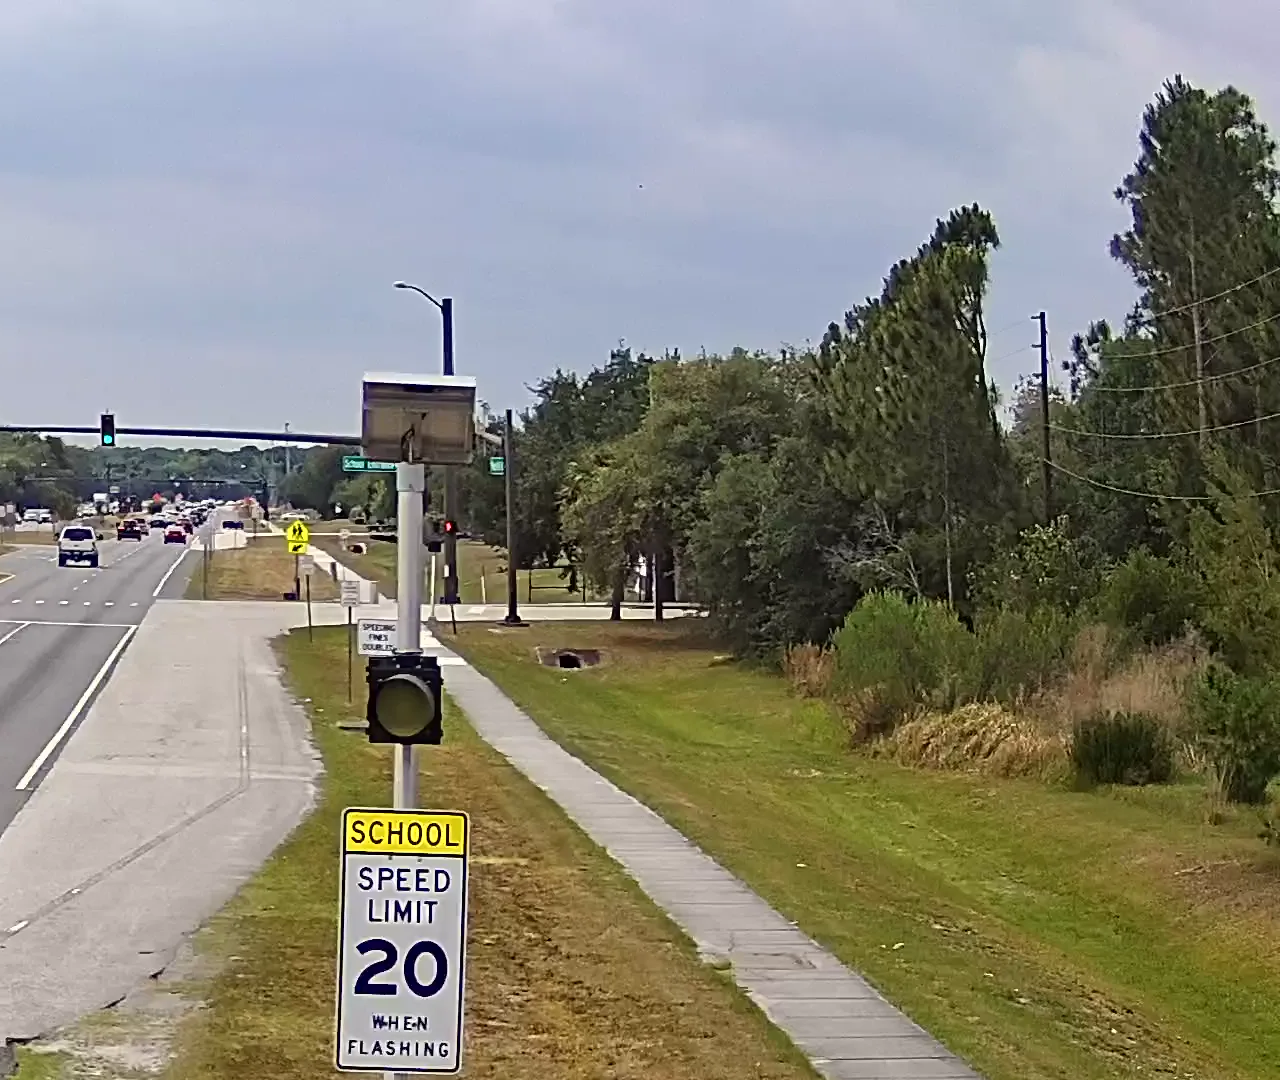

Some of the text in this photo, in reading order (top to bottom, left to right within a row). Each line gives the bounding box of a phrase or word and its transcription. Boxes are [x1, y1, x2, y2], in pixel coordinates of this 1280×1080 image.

[368, 633, 389, 642] FINES
[351, 820, 460, 847] SCHOOL
[357, 866, 451, 893] SPEED
[368, 899, 439, 924] LIMIT
[354, 938, 448, 998] 20
[372, 1015, 428, 1031] WHEN
[347, 1039, 449, 1058] FLASHING
